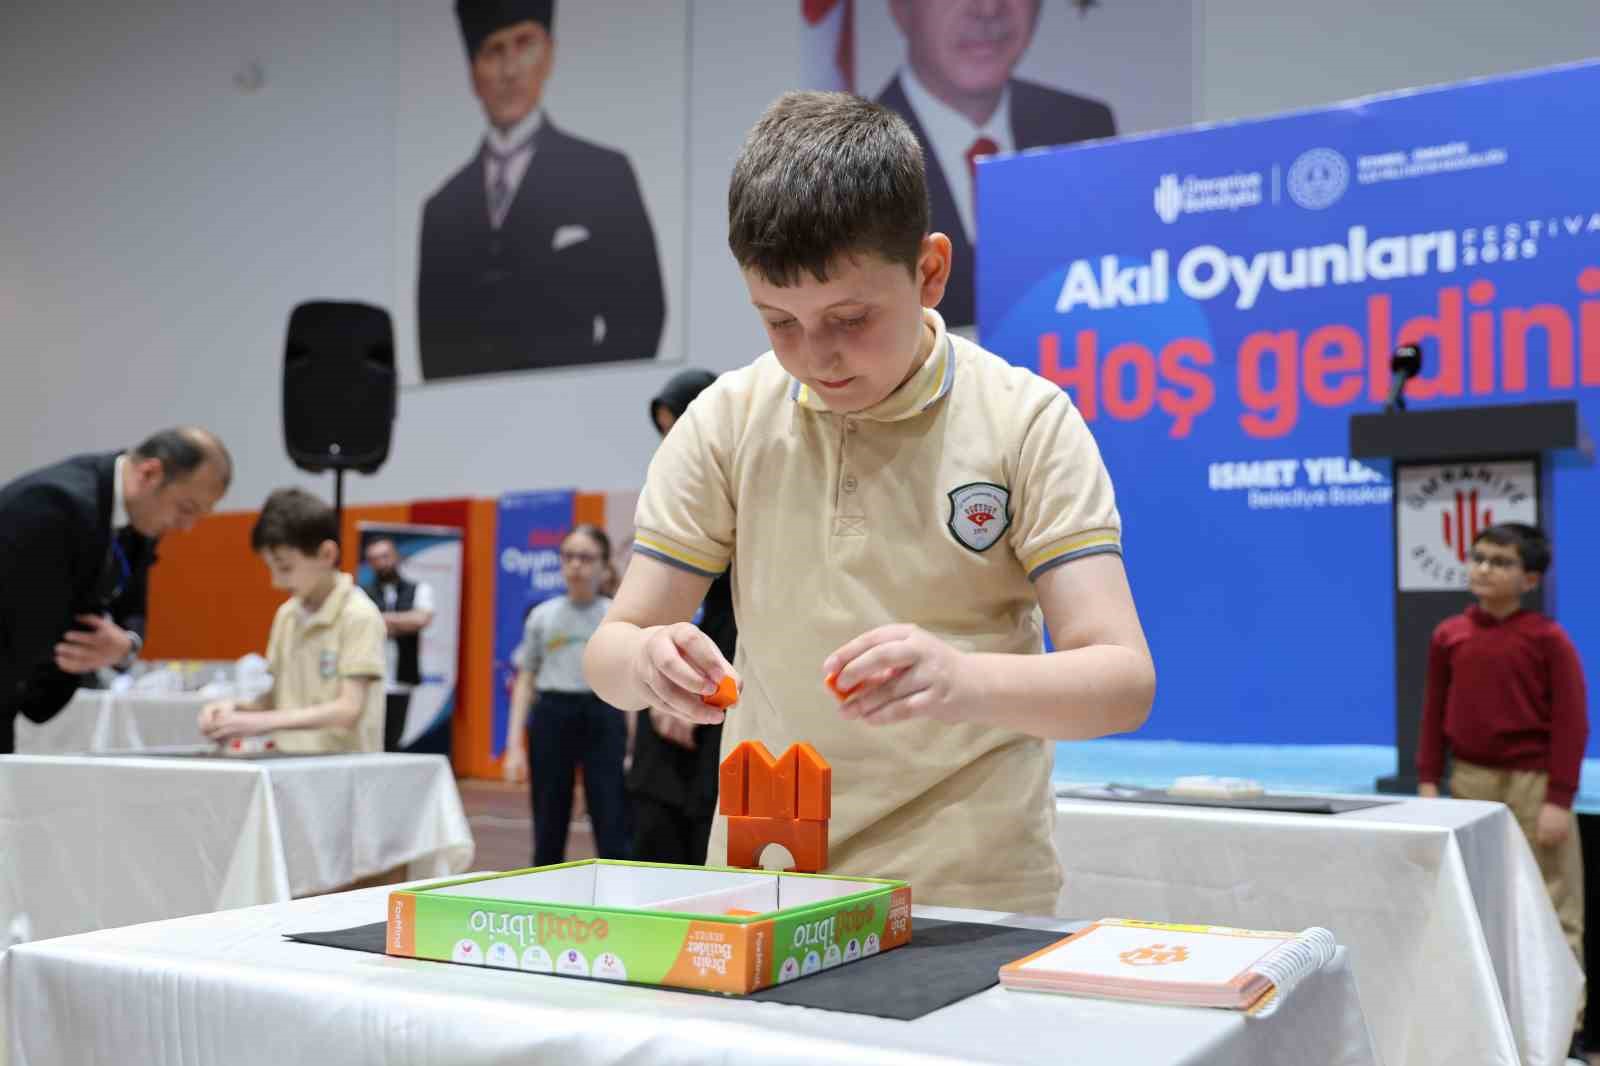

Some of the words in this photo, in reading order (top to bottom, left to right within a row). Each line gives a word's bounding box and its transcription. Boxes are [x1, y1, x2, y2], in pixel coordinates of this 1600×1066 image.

[1056, 249, 1168, 313] Akıl
[1178, 226, 1456, 309] Oyunları
[1039, 329, 1215, 439] Hoş
[1238, 266, 1600, 439] geldini
[468, 910, 610, 947] equilibrio
[687, 941, 733, 958] Builder
[692, 955, 727, 976] Brain
